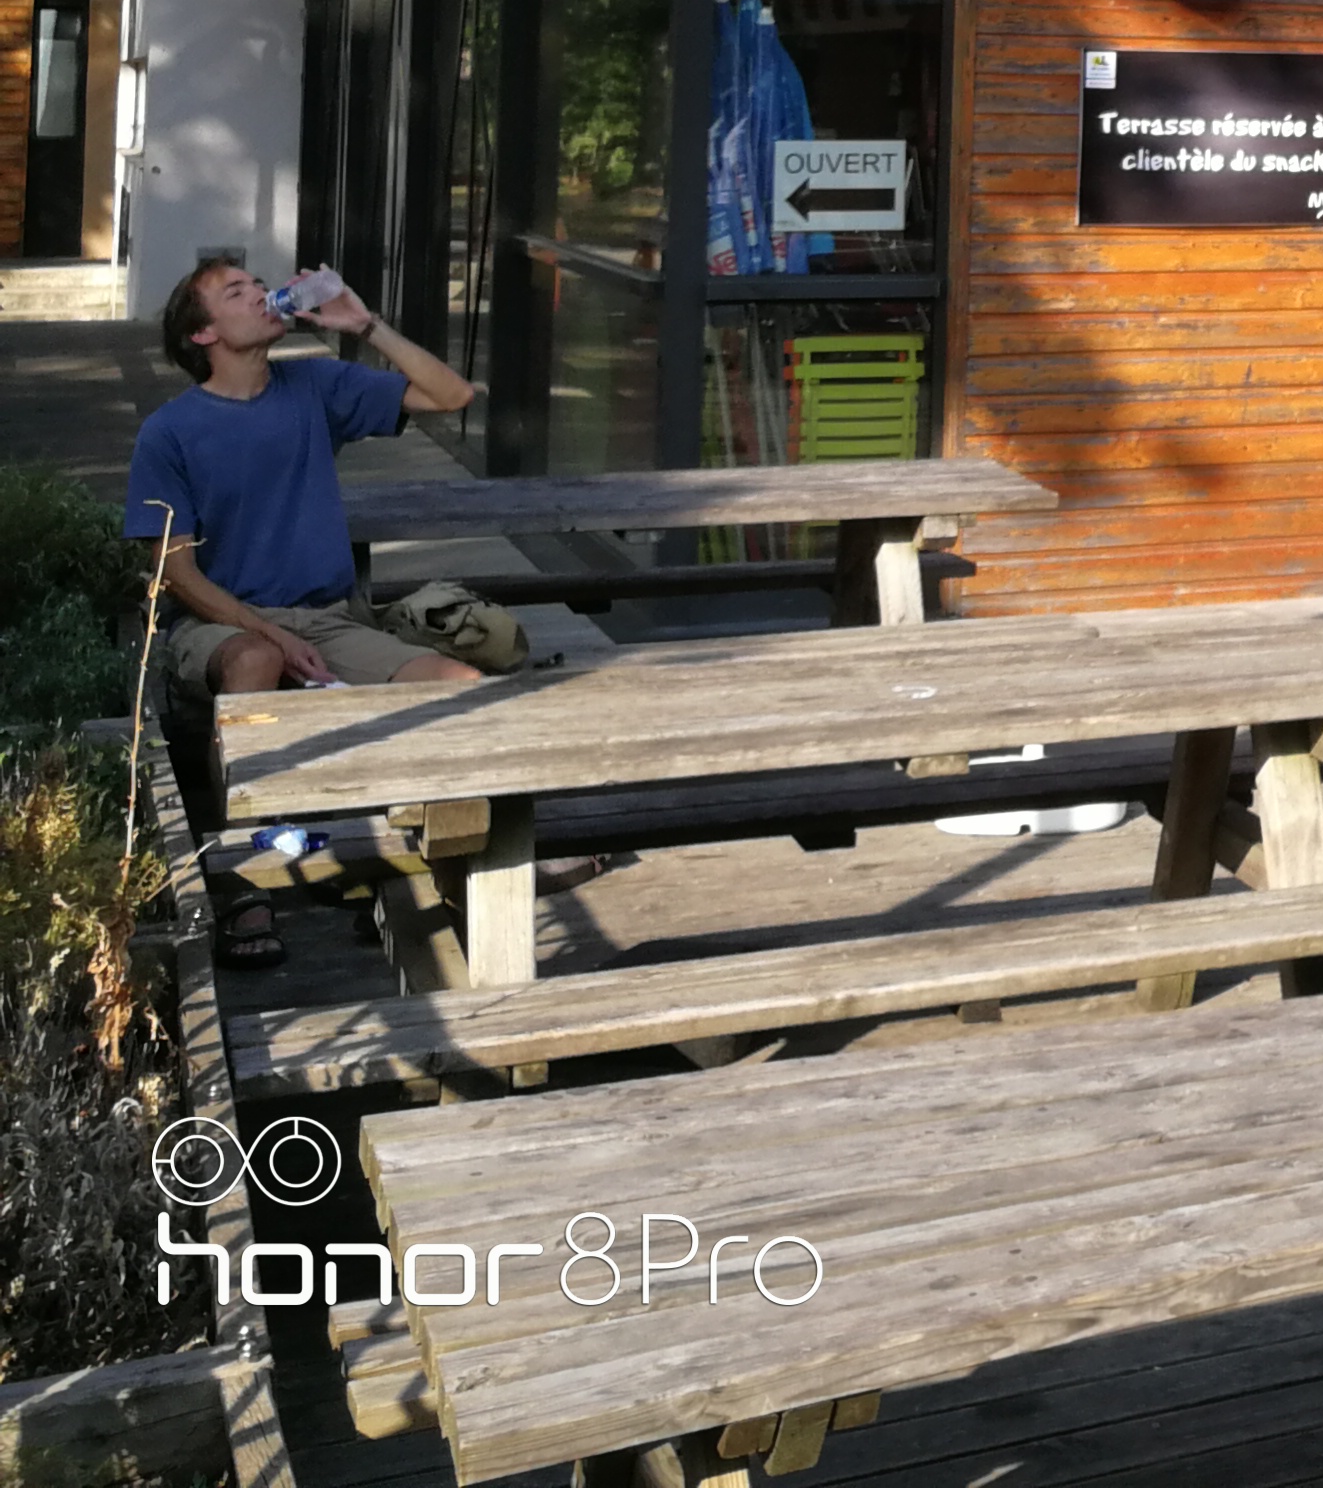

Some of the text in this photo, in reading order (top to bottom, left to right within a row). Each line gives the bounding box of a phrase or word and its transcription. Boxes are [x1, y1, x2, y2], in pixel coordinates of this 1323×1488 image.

[1098, 112, 1205, 137] Terrasse
[1212, 112, 1306, 138] réservée
[784, 153, 898, 174] OUVERT
[1121, 147, 1224, 173] clientèle
[1230, 149, 1256, 172] du
